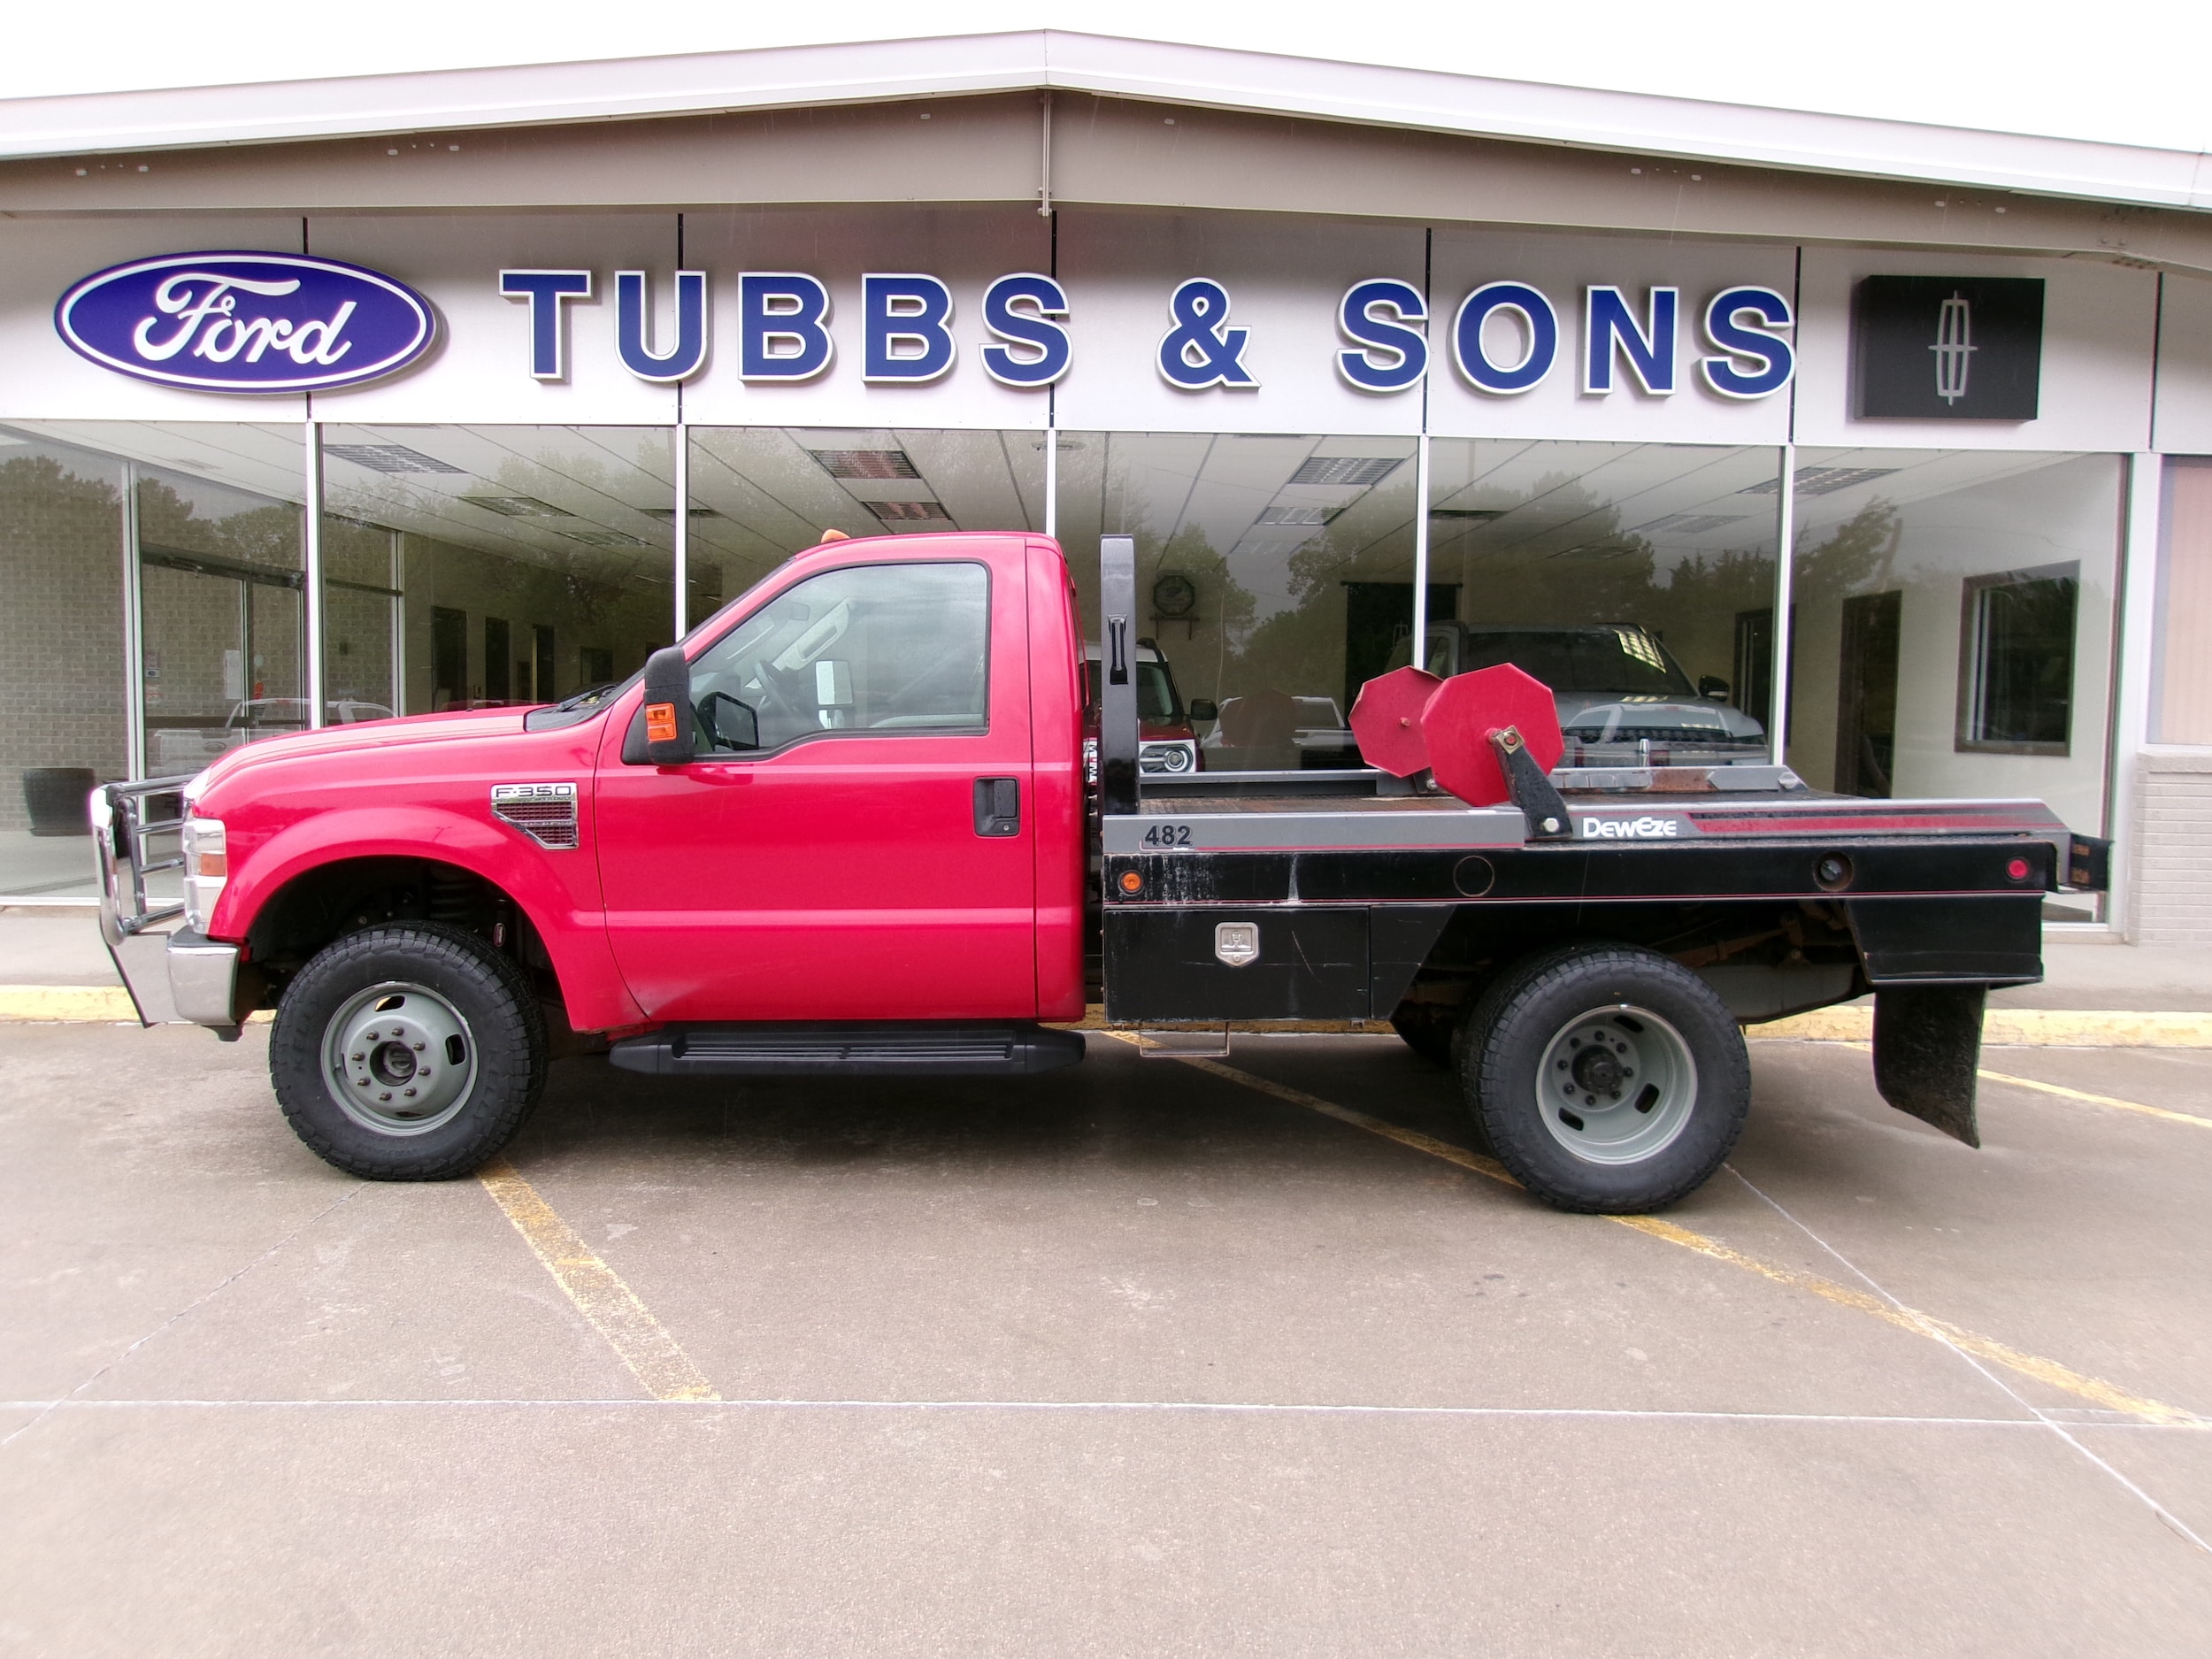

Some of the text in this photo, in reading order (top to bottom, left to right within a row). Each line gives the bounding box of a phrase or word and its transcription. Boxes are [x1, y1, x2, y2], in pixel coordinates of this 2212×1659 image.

[133, 273, 357, 365] Ford
[498, 269, 1797, 399] TUBBS & SONS
[495, 786, 572, 797] F-350
[1144, 825, 1192, 846] 482
